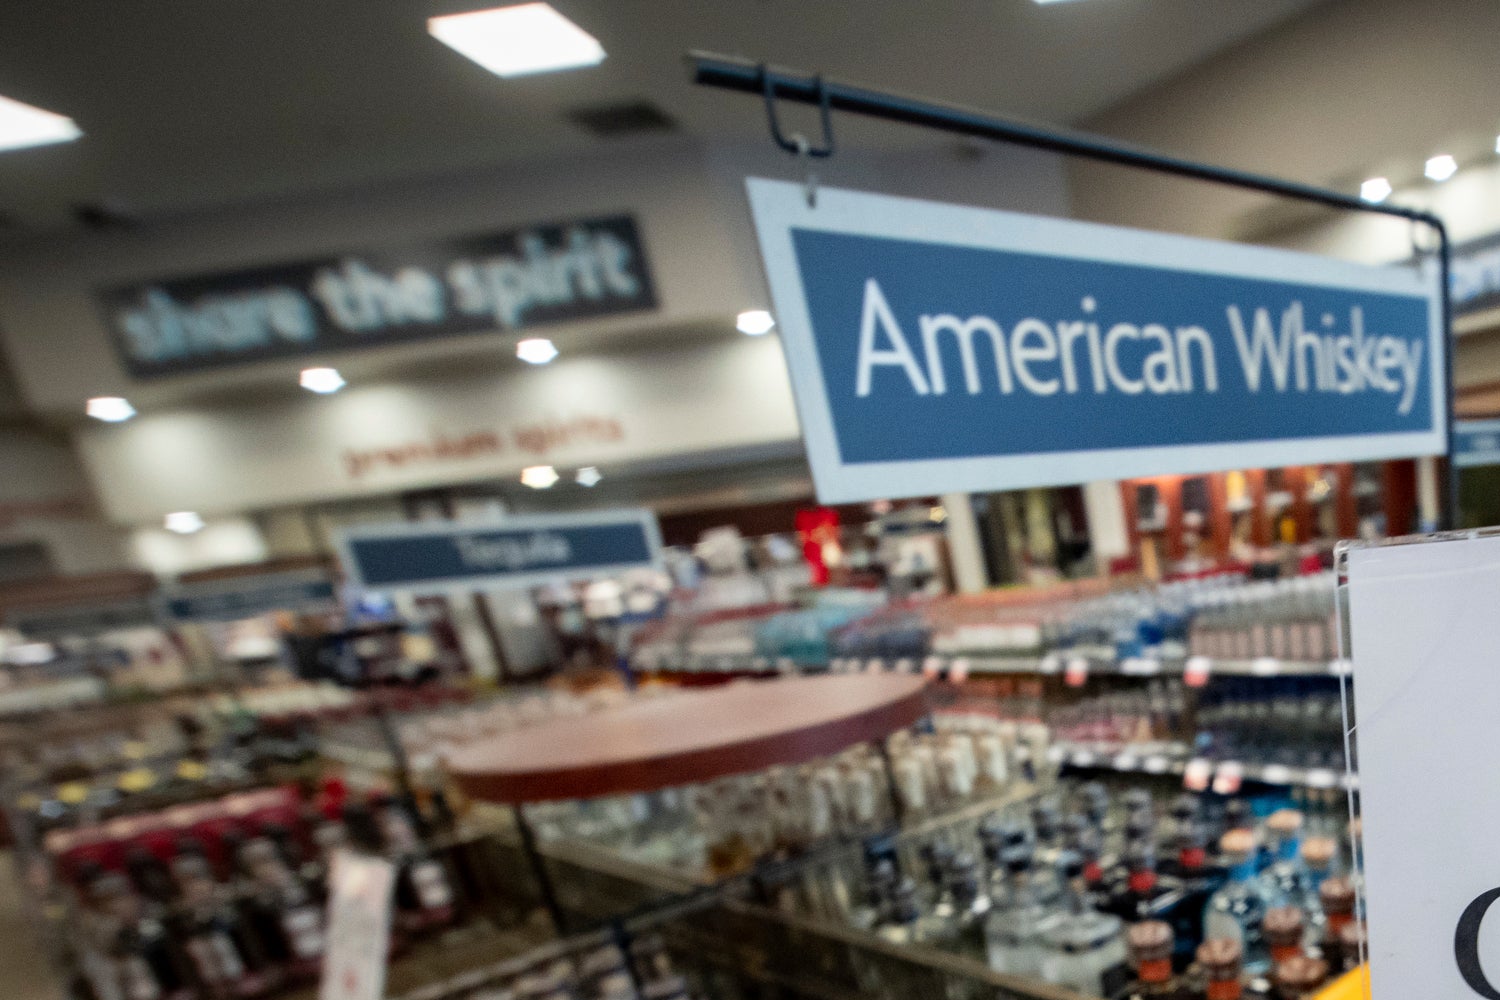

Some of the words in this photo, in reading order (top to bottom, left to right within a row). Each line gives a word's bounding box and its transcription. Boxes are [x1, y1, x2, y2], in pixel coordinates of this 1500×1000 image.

[117, 286, 317, 363] share
[313, 256, 446, 334] the
[446, 225, 639, 330] spirit
[855, 278, 1219, 398] American
[1226, 300, 1424, 415] Whiskey
